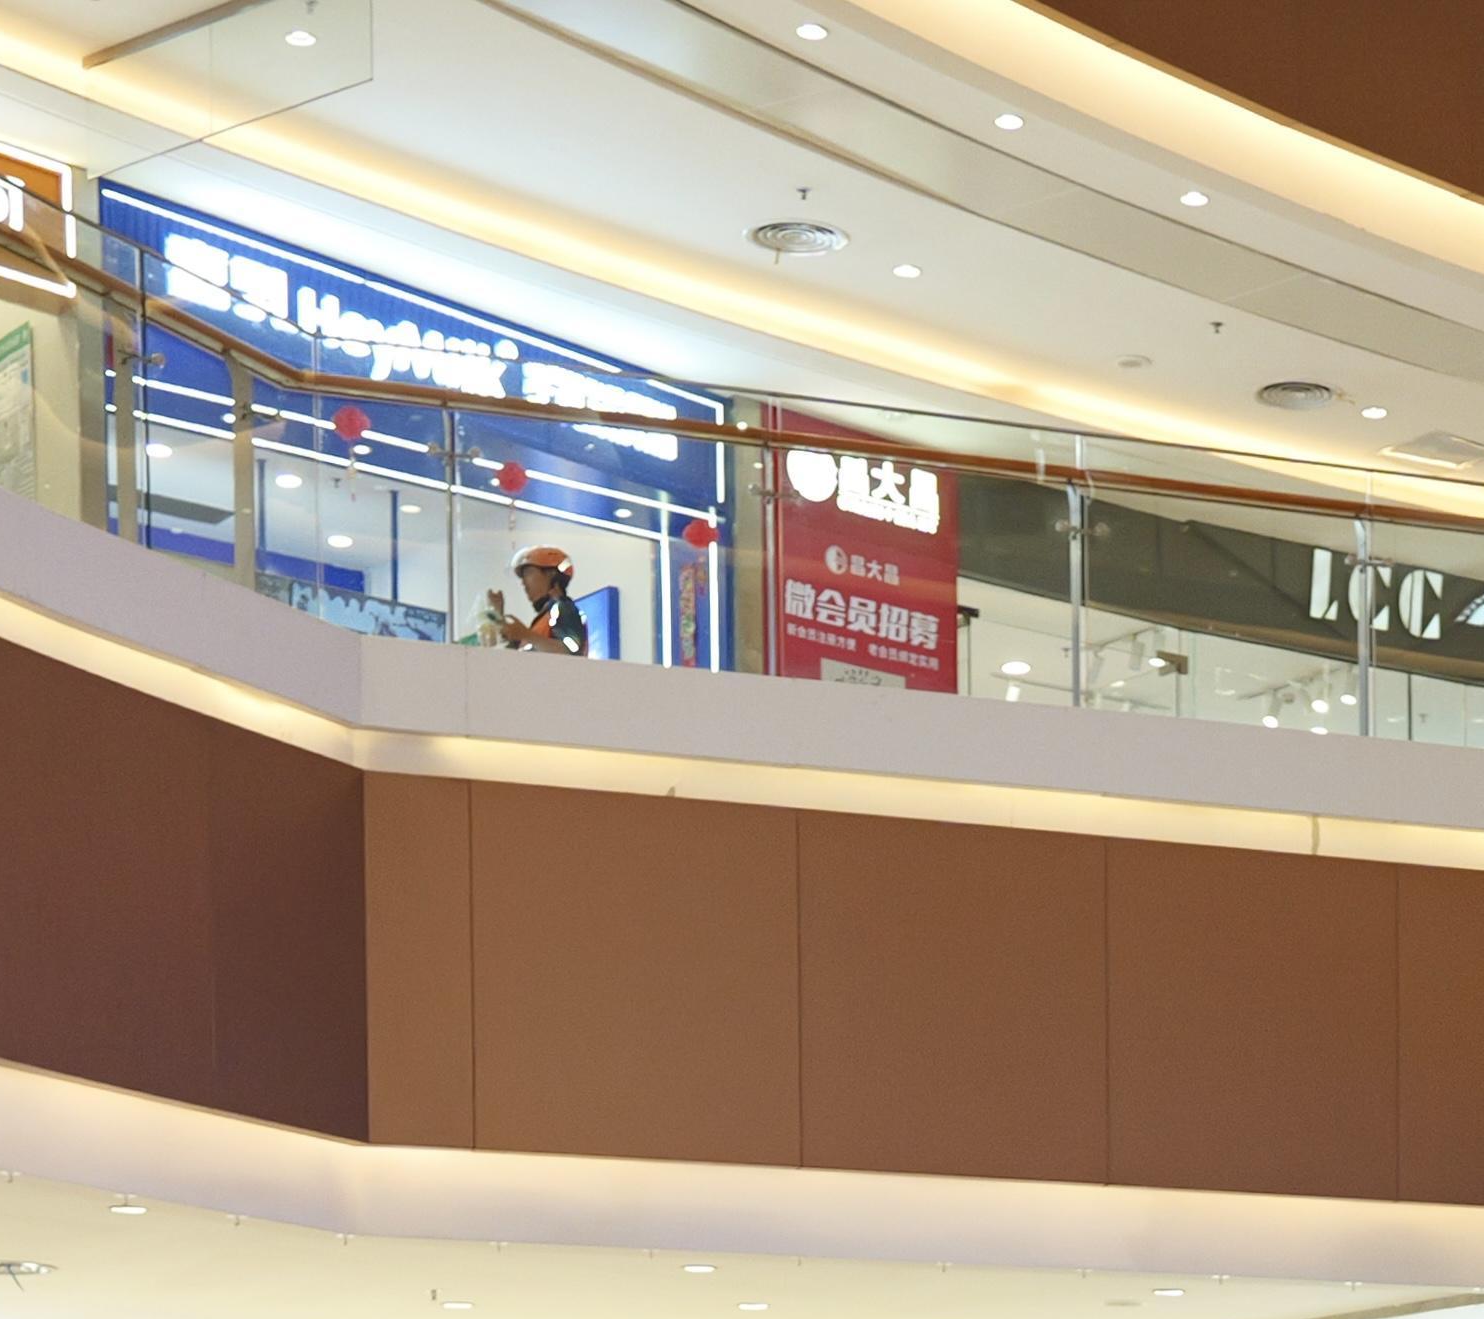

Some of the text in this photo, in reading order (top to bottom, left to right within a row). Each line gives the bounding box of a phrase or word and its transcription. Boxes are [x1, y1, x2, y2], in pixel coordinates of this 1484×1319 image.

[785, 578, 940, 650] 微会员招募
[1310, 548, 1444, 640] LCC
